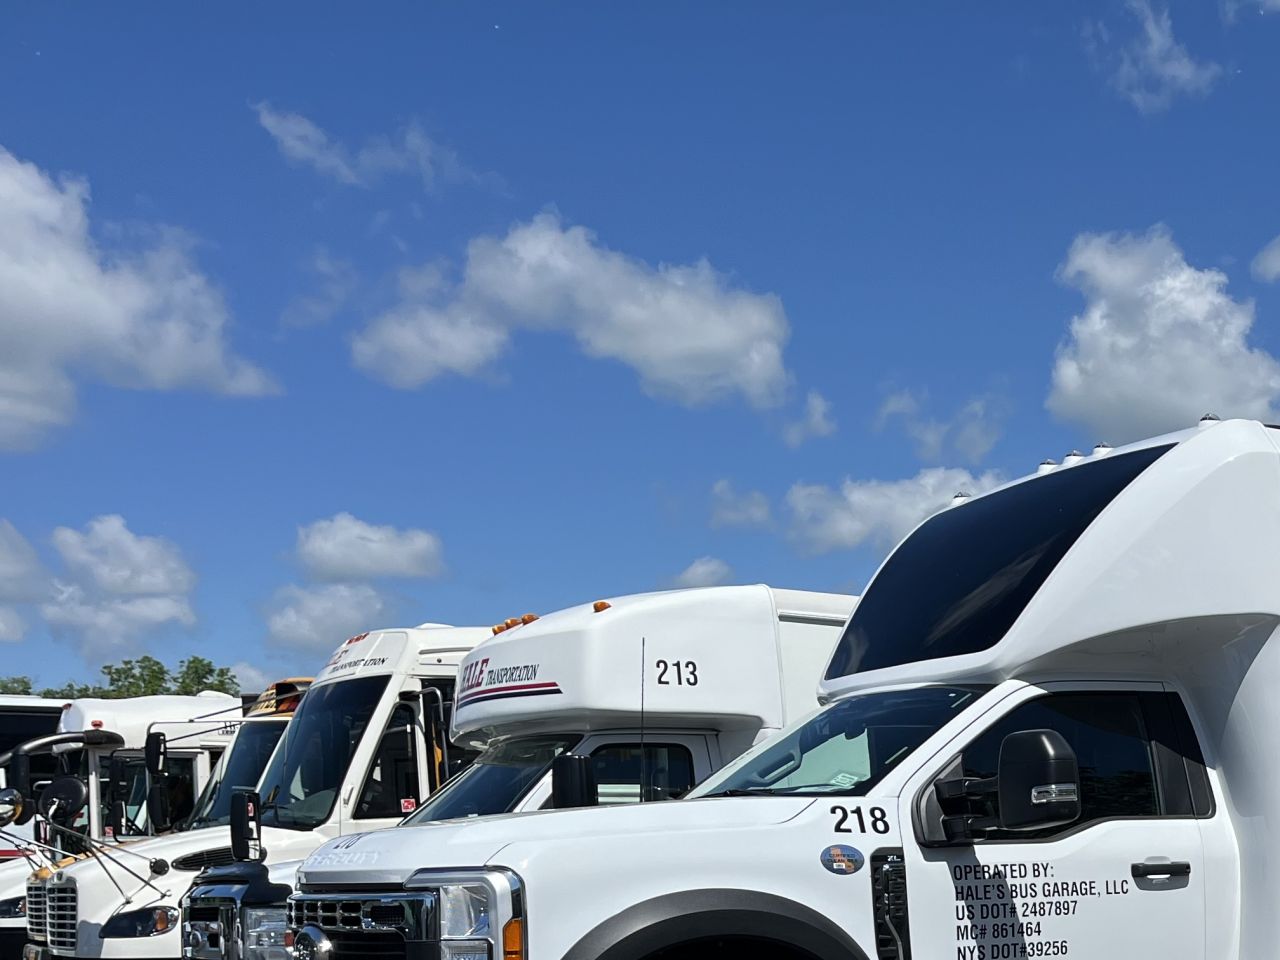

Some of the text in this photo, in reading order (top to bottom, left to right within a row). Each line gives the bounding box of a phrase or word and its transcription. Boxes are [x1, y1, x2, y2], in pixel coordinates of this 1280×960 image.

[485, 664, 540, 687] TRANSPORTATION
[656, 658, 698, 686] 213
[830, 805, 890, 834] 218
[953, 862, 1054, 880] OPERATED BY:
[955, 879, 1129, 901] HALE'S BUS GARAGE, LLC
[955, 900, 1078, 920] US DOT# 2487897
[956, 921, 1042, 940] MC# 861464
[991, 940, 1068, 960] DOT#39256
